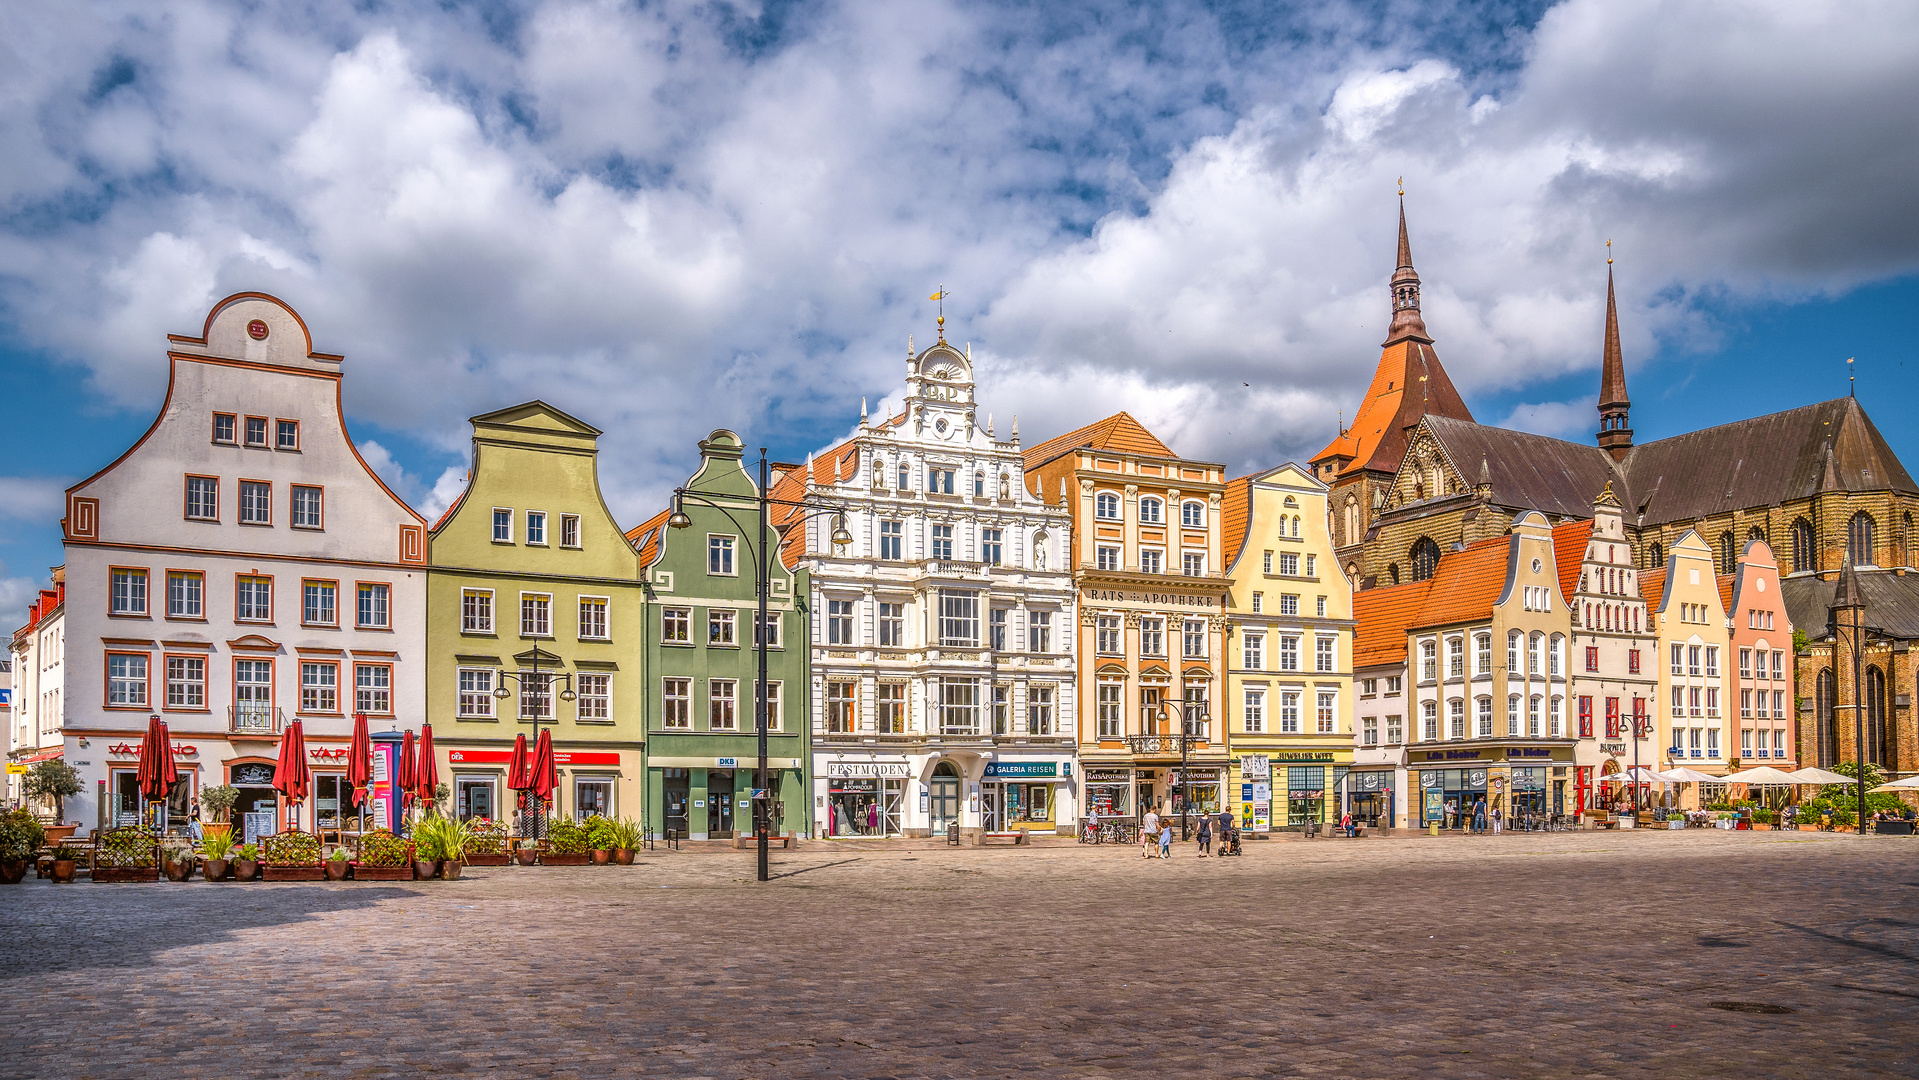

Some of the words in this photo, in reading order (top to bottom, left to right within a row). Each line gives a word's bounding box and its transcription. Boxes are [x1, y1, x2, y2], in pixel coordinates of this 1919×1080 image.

[1091, 589, 1124, 602] RATS
[1143, 593, 1213, 607] APOTHEKE
[108, 742, 197, 757] VAPNO
[830, 764, 905, 775] FESTMODEN
[997, 765, 1026, 773] GALERIA
[1027, 765, 1055, 773] REISEN
